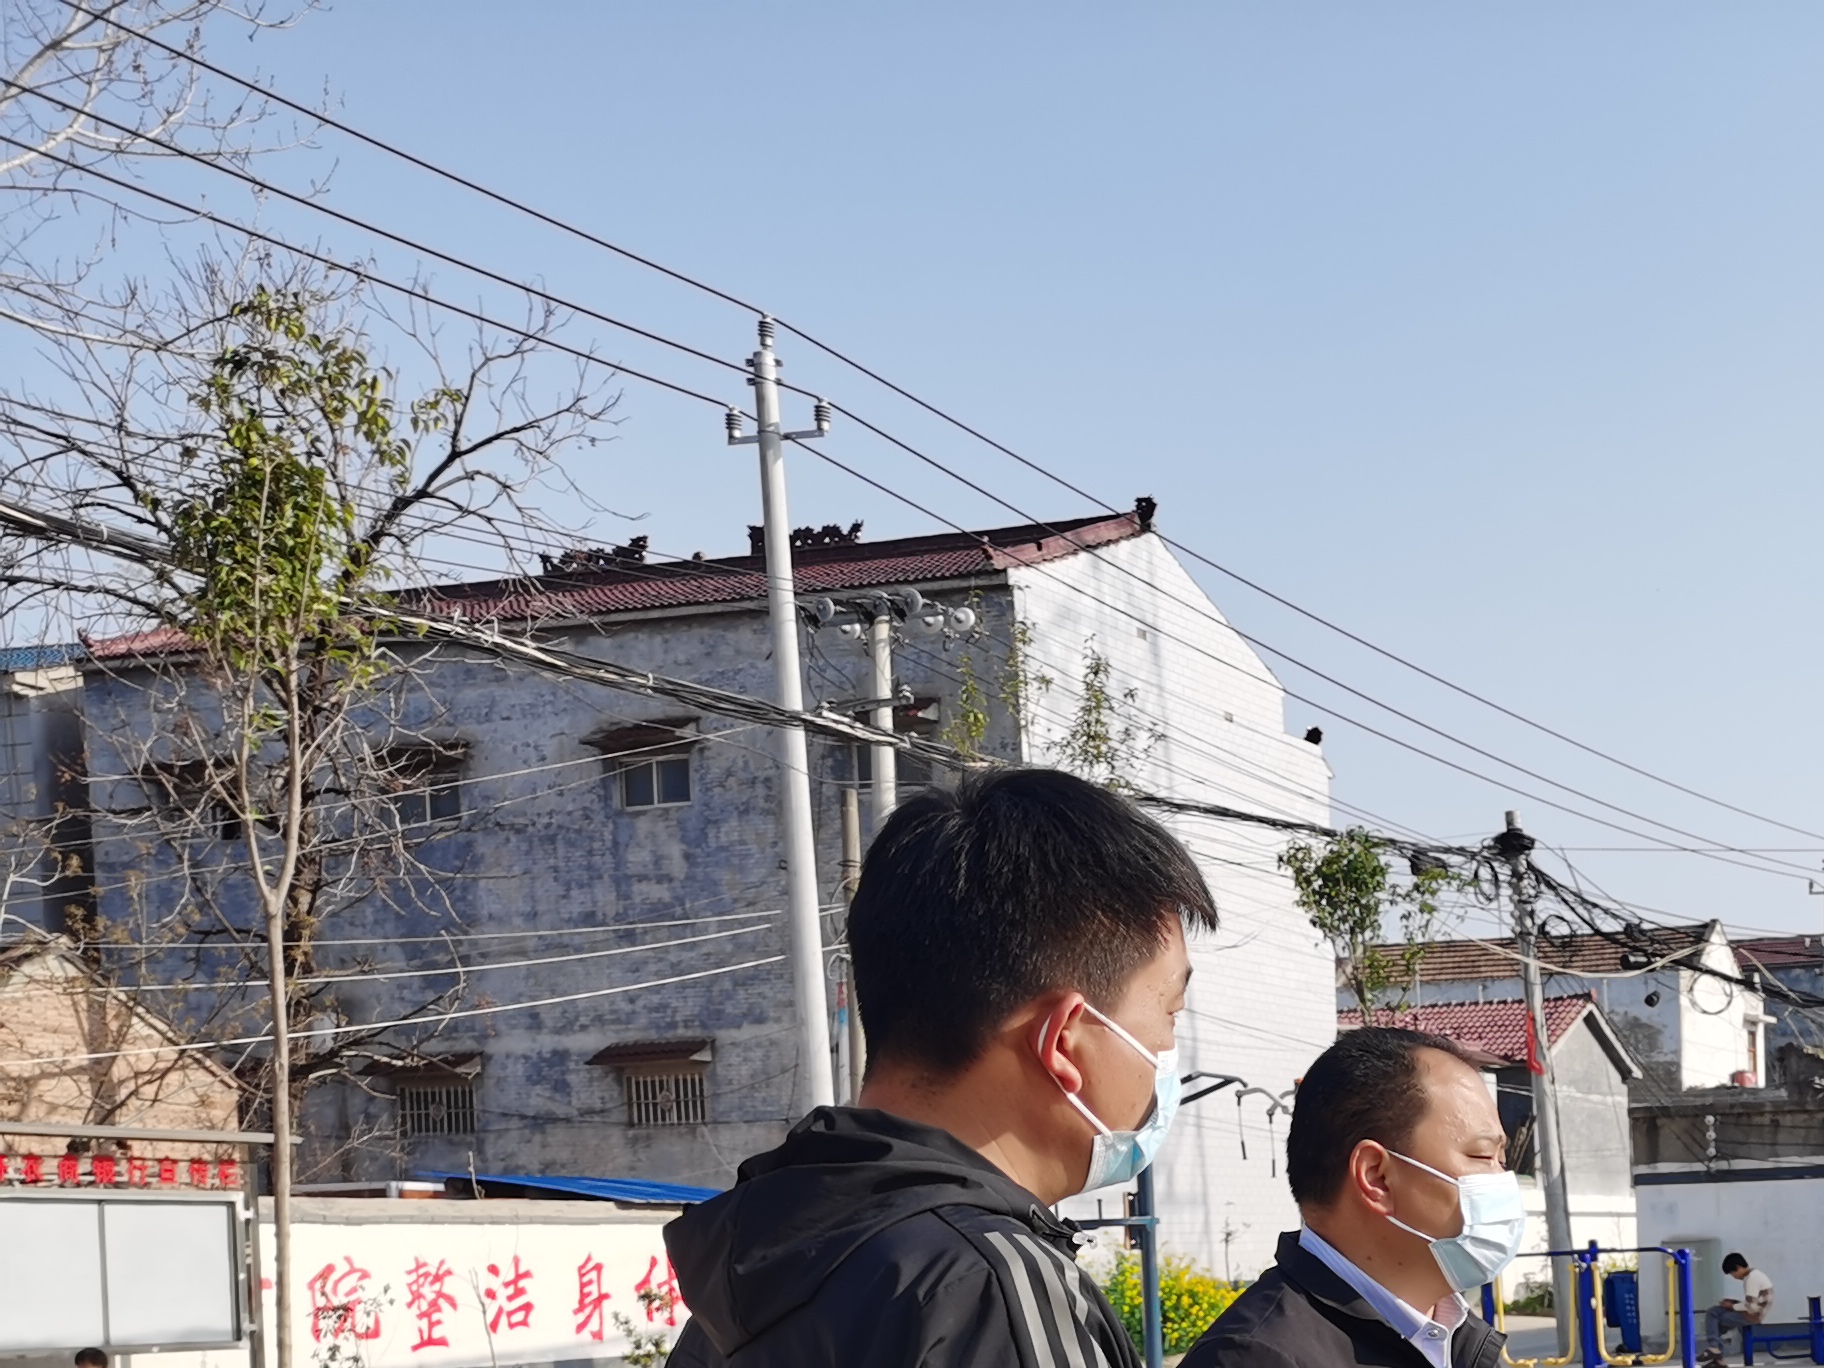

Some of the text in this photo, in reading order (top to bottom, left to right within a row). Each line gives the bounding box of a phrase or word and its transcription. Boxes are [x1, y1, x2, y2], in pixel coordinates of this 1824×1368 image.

[259, 1250, 690, 1352] 院整洁身体
